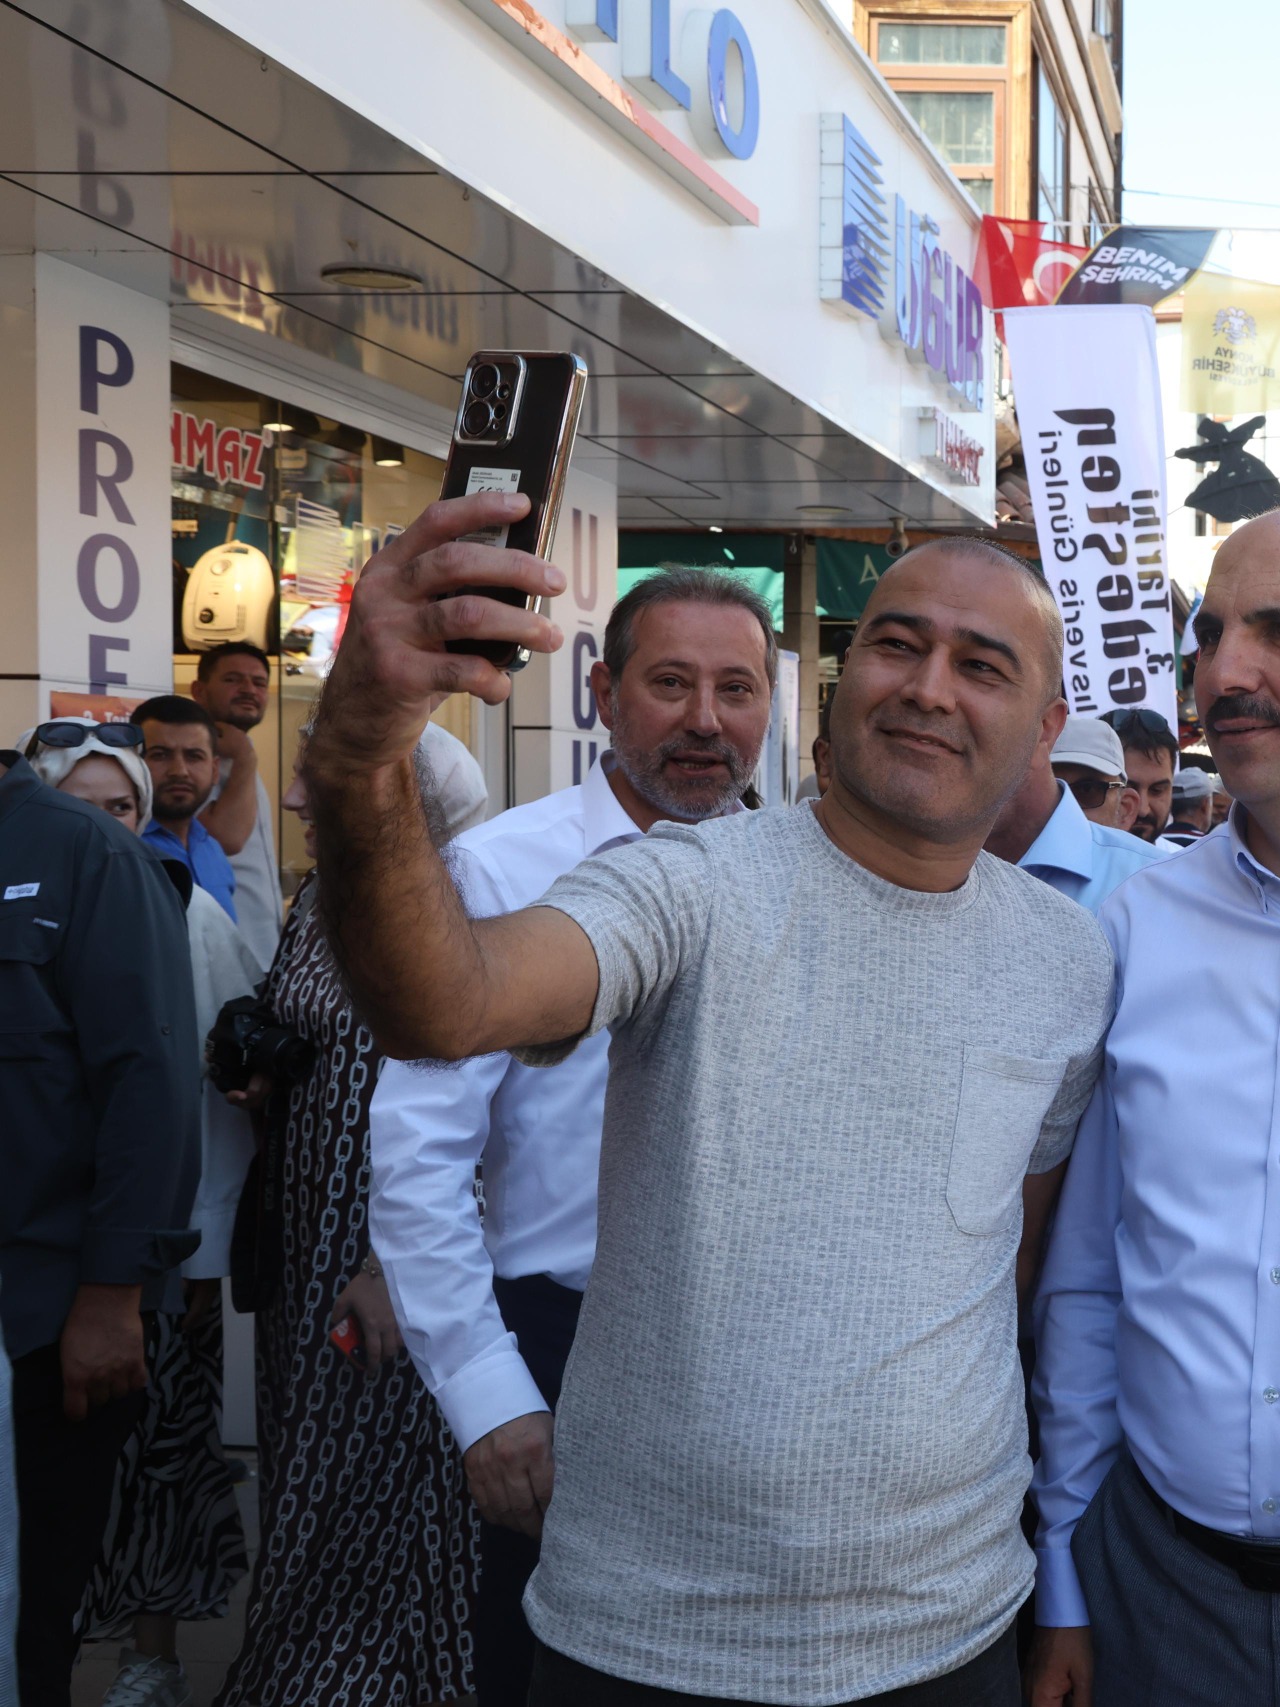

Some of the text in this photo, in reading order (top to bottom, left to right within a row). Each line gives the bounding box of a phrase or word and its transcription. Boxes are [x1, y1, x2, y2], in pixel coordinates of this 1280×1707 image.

[595, 0, 759, 160] LO
[895, 192, 983, 412] UĞUR
[1080, 265, 1174, 290] ŞEHRİM
[1093, 246, 1189, 281] BENİM
